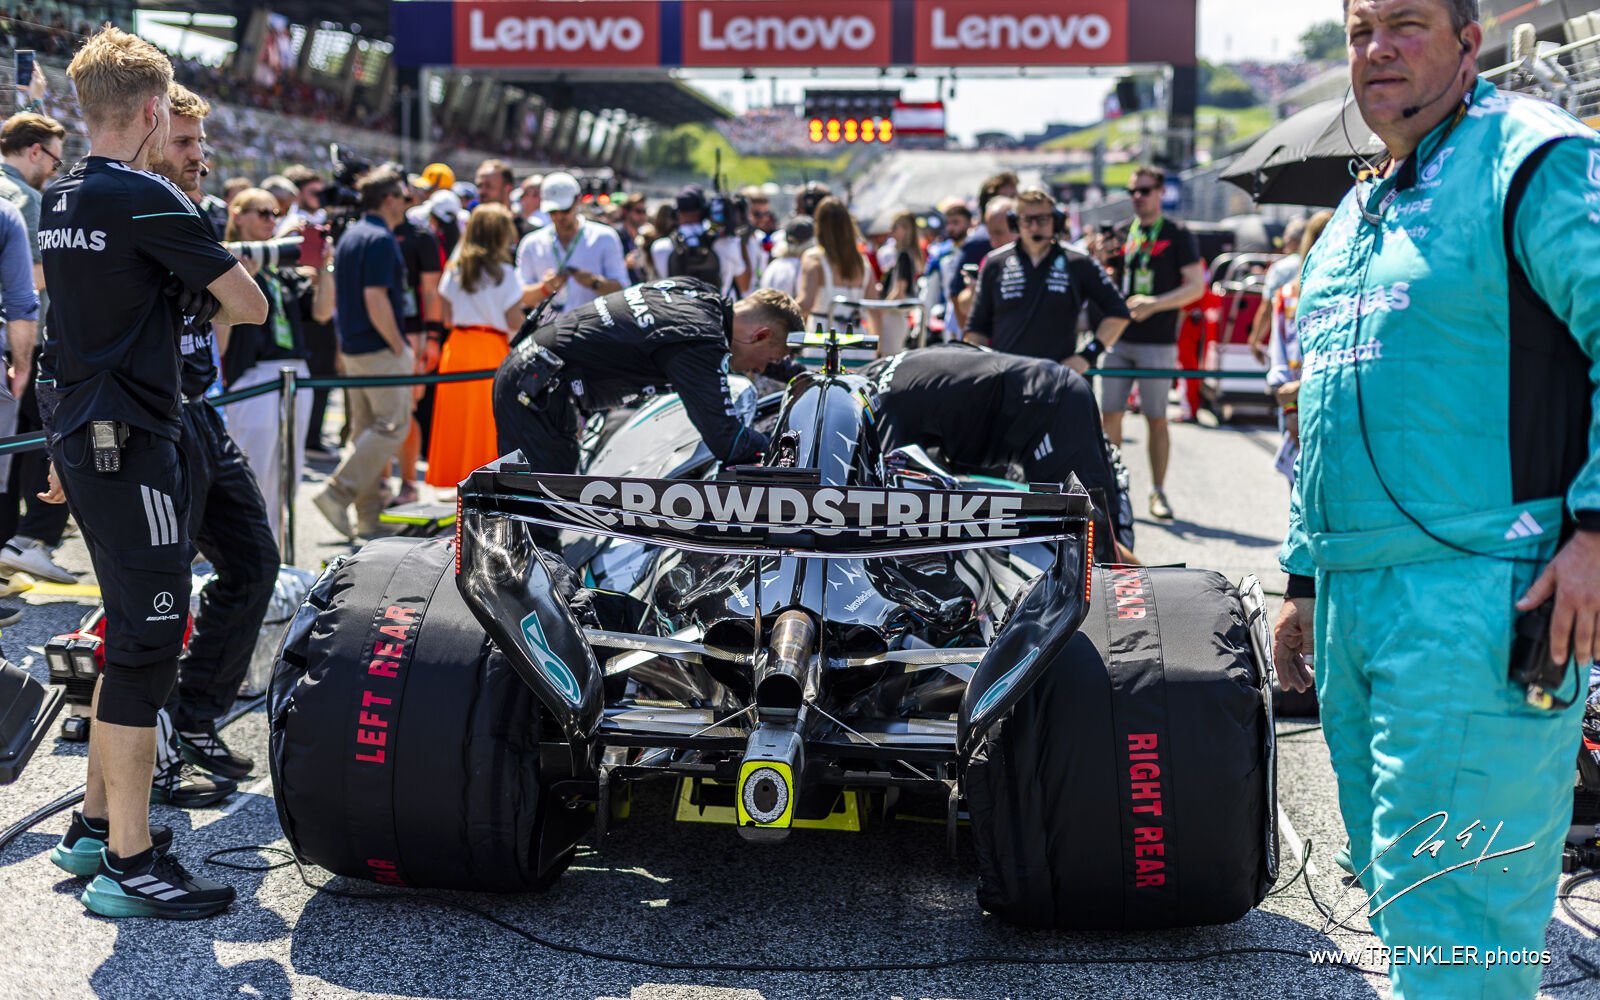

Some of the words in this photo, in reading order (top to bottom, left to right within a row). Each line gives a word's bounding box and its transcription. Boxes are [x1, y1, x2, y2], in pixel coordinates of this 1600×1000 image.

[470, 10, 643, 51] Lenovo
[699, 10, 876, 51] Lenovo
[931, 8, 1111, 50] Lenovo
[1396, 199, 1434, 216] HPE
[579, 480, 1023, 538] CROWDSTRIKE
[368, 605, 417, 679] REAR
[355, 690, 392, 764] LEFT
[1127, 732, 1163, 817] RIGHT
[1134, 826, 1166, 889] REAR
